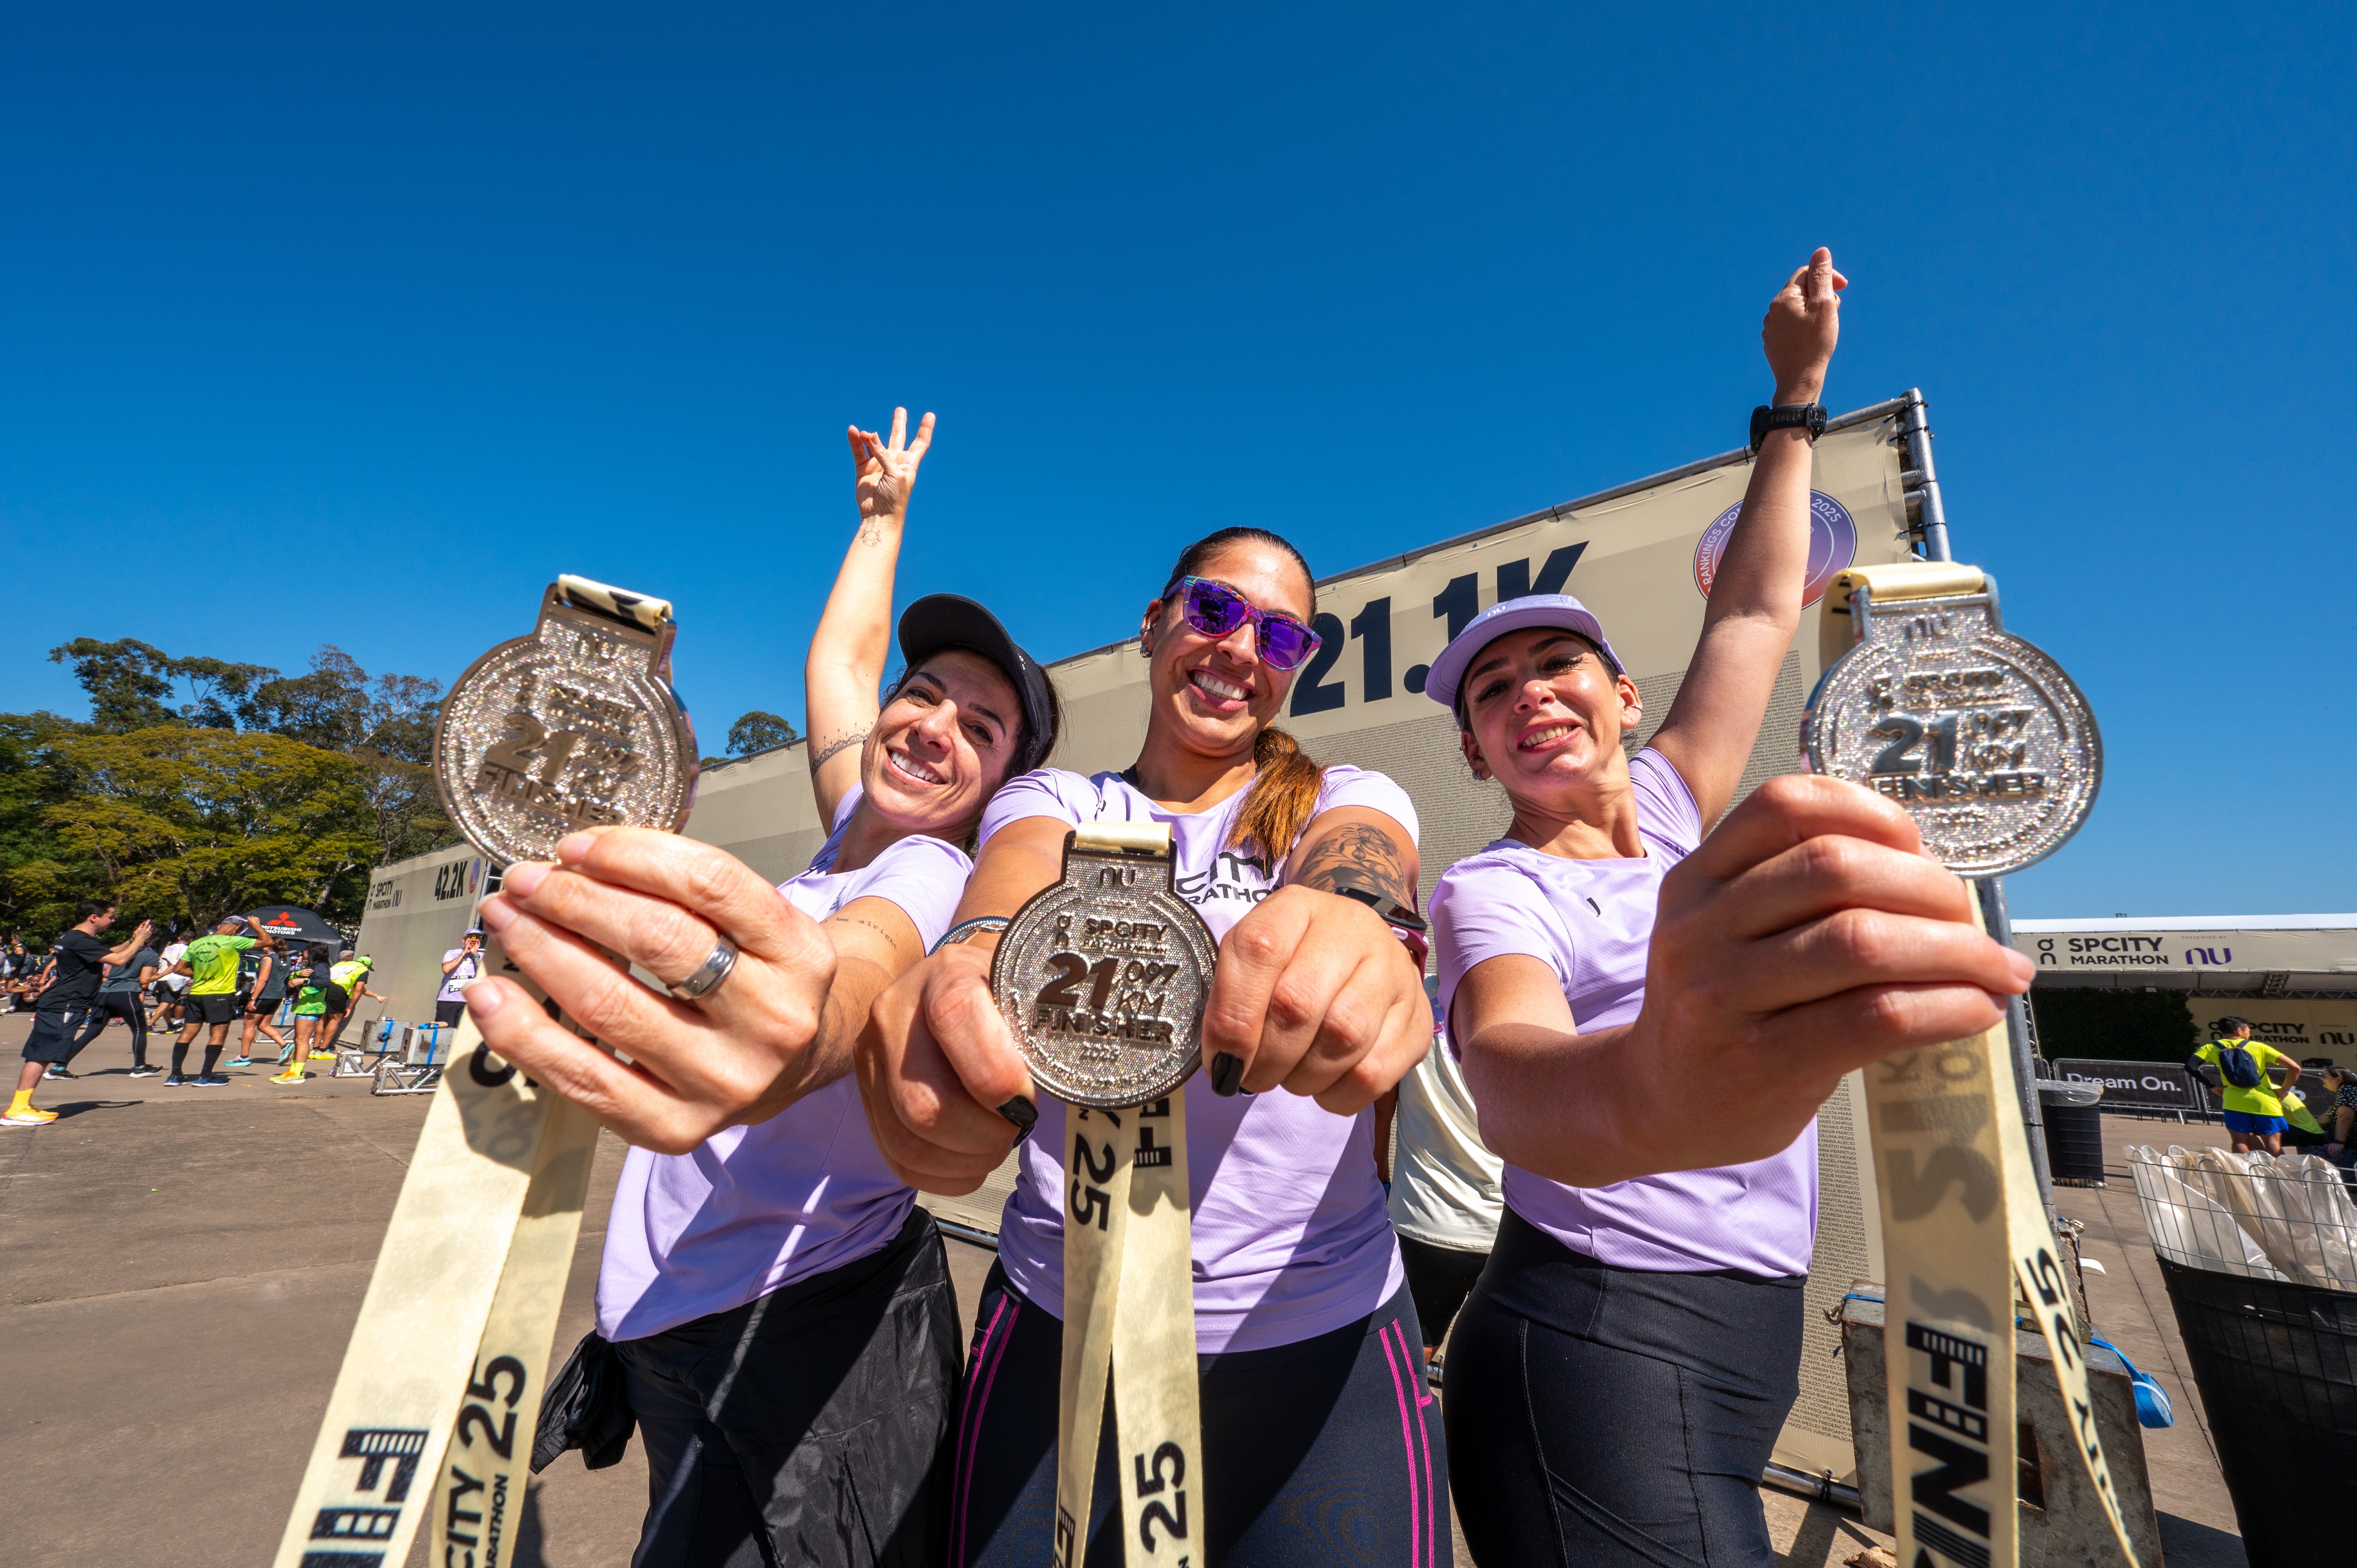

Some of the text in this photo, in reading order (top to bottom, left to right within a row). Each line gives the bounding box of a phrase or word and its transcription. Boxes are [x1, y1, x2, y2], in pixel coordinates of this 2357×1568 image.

[1811, 499, 1842, 523] 2025
[1700, 528, 1721, 585] RANKINGS
[1487, 606, 1505, 617] nu
[1871, 770, 2046, 800] FINISHER
[478, 766, 626, 825] FINISHER
[435, 861, 468, 901] 42.2K
[1099, 867, 1135, 886] nu
[1176, 852, 1274, 894] CITY
[376, 880, 394, 897] SPCITY
[373, 899, 391, 910] MARATHON
[1085, 918, 1168, 941] SPCITY
[2068, 937, 2163, 952] SPCITY
[2071, 955, 2169, 964] MARATHON
[2185, 947, 2232, 965] nu
[1117, 990, 1165, 1015] KM
[1032, 1008, 1174, 1043] FINISHER
[2250, 1022, 2305, 1034] PCITY
[2320, 1032, 2354, 1045] nu
[2067, 1073, 2182, 1091] Dream On.
[1071, 1132, 1116, 1232] 25
[1803, 1348, 1828, 1358] STEPHANO
[1810, 1376, 1828, 1384] THIAGO
[1827, 1390, 1847, 1398] VAGNER
[1809, 1401, 1832, 1411] VICTORIA
[1819, 1420, 1846, 1431] FREDERICK
[1813, 1429, 1852, 1443] JUNIOR WILSON
[445, 1356, 526, 1568] CITY 25
[1135, 1441, 1188, 1554] 25
